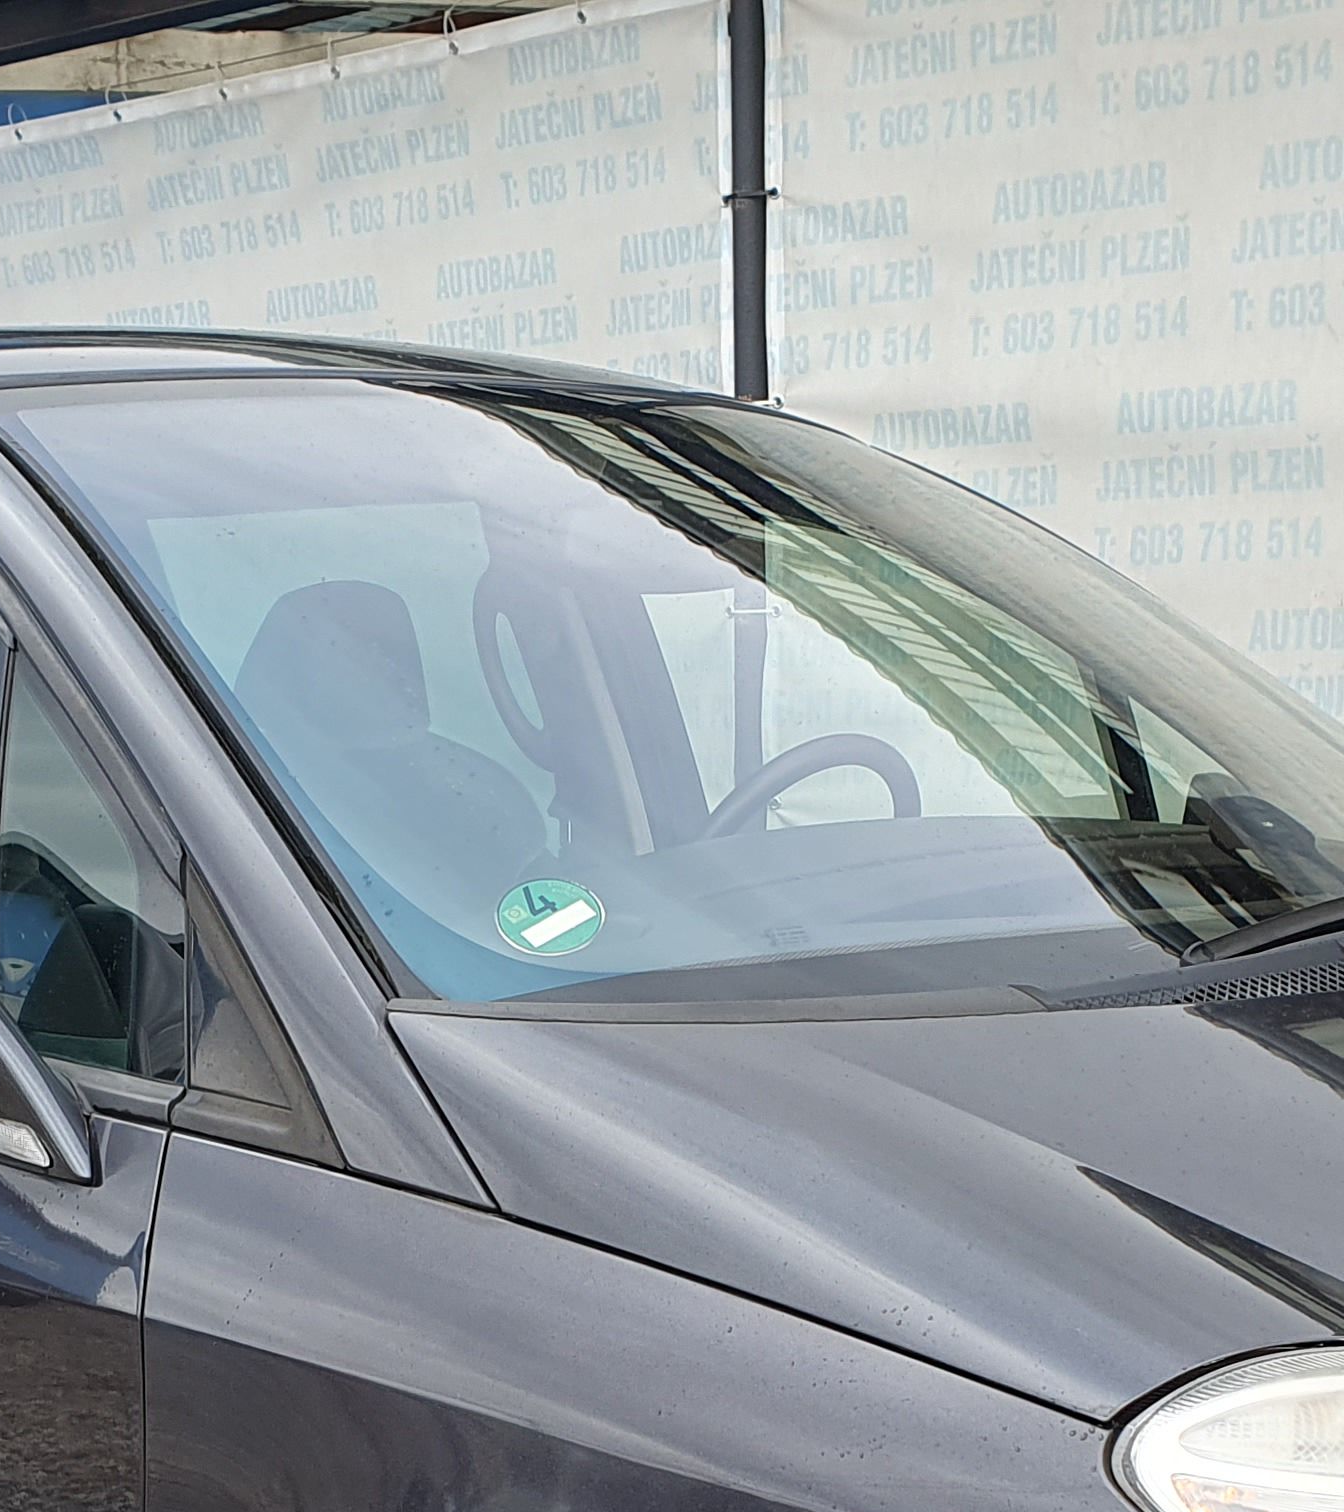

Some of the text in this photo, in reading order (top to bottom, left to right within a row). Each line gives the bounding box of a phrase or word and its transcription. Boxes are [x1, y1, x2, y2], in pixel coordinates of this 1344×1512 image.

[508, 24, 641, 85] AUTOBAZAR
[846, 3, 1056, 89] JATEČNÍ PLZEŇ
[1135, 39, 1333, 111] 603 718 514
[323, 65, 444, 123] AUTOBAZAR
[495, 81, 588, 151] JATEČNÍ
[595, 73, 663, 131] PLZEŇ
[879, 84, 1058, 149] 603 718 514
[155, 103, 265, 155] AUTOBAZAR
[316, 109, 470, 185] JATEČNÍ PLZEŇ
[71, 180, 125, 224] PLZEŇ
[148, 145, 291, 208] JATEČNÍ PLZEŇ
[528, 147, 665, 205] 603 718 514
[993, 162, 1168, 224] AUTOBAZAR
[180, 209, 302, 261] 603 718 514
[349, 180, 475, 235] 603 718 514
[22, 238, 136, 285] 603 718 514
[436, 248, 556, 300] AUTOBAZAR
[851, 245, 933, 305] PLZEŇ
[971, 214, 1191, 292] JATEČNÍ PLZEŇ
[266, 277, 378, 325] AUTOBAZAR
[515, 295, 578, 346] PLZEŇ
[605, 277, 692, 336] JATEČNÍ
[1004, 296, 1188, 355] 603 718 514
[1268, 281, 1326, 328] 603
[824, 324, 932, 370] 718 514
[1117, 379, 1297, 435] AUTOBAZAR
[1097, 433, 1325, 503] JATEČNÍ PLZEŇ
[1129, 516, 1323, 567] 603 718 514
[522, 885, 558, 916] 4
